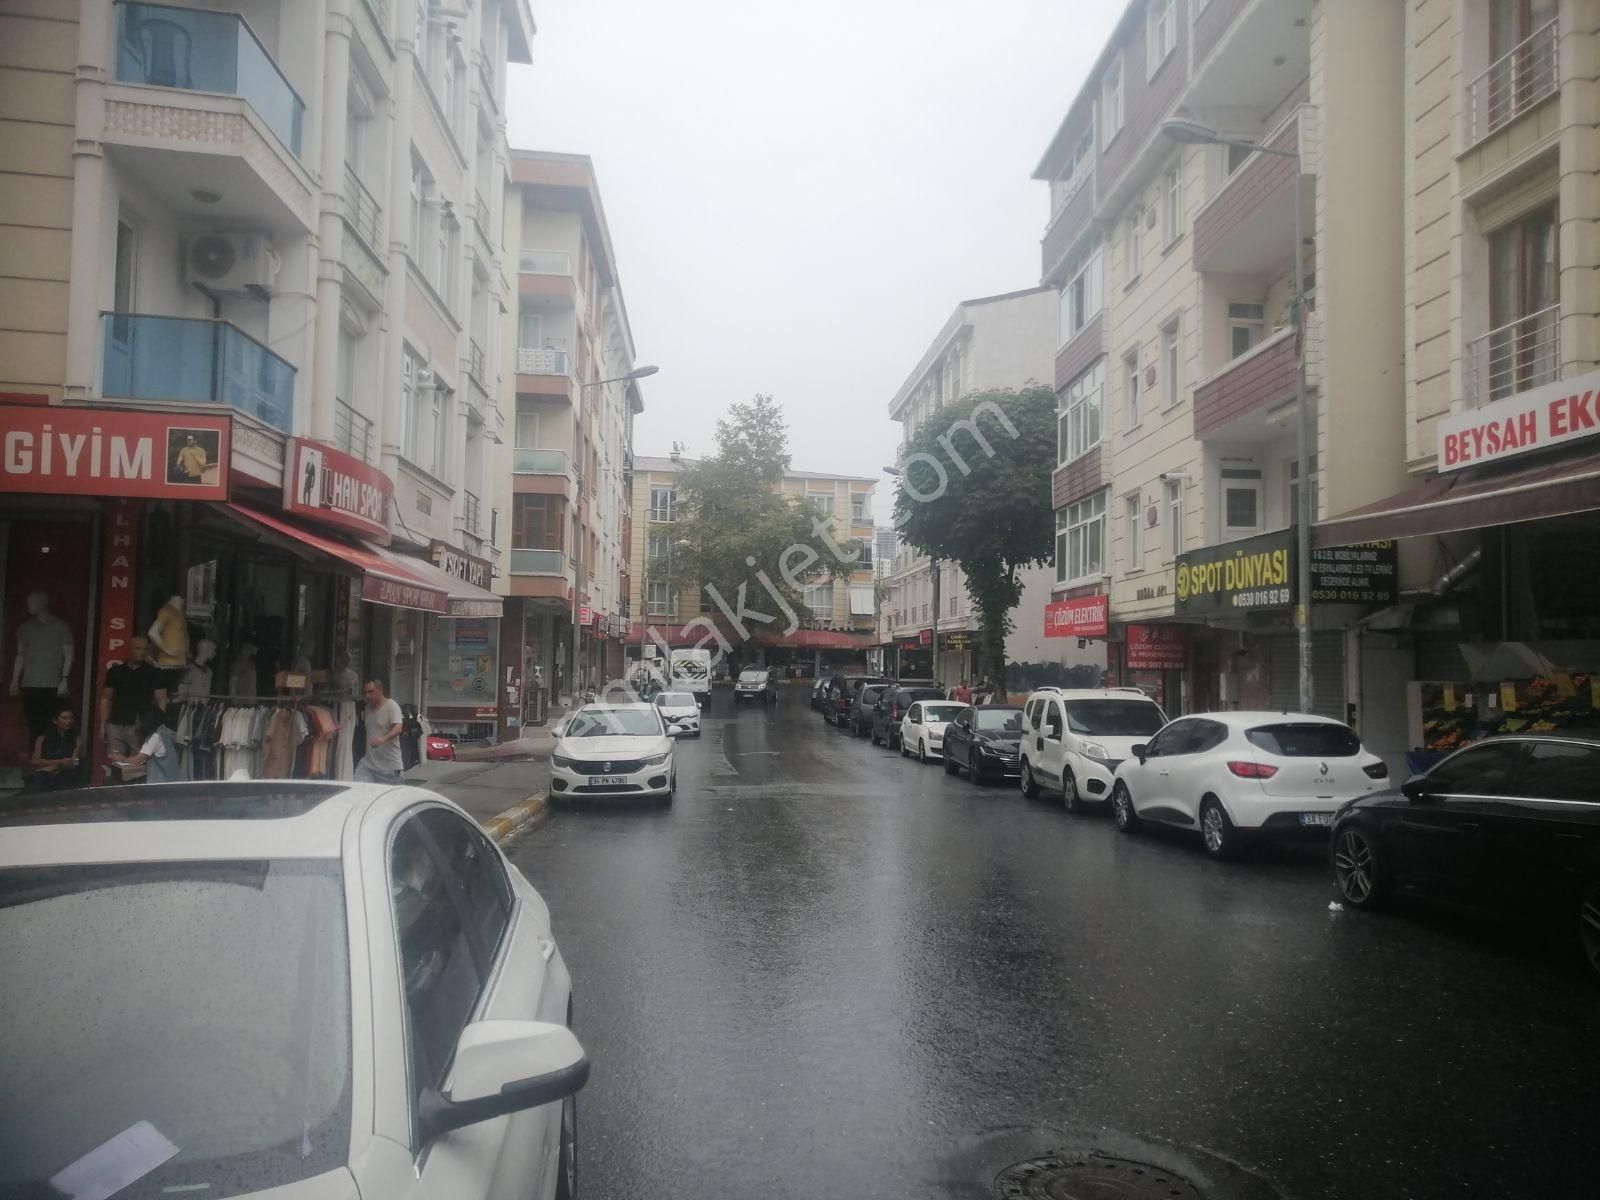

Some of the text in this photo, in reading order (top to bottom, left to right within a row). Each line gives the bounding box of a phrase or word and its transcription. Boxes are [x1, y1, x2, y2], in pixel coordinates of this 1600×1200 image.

[4, 423, 153, 480] GİYİM
[1190, 560, 1223, 595] SPOT
[1225, 549, 1289, 591] DÜNYASI
[1237, 587, 1290, 608] 0530 016 92 69
